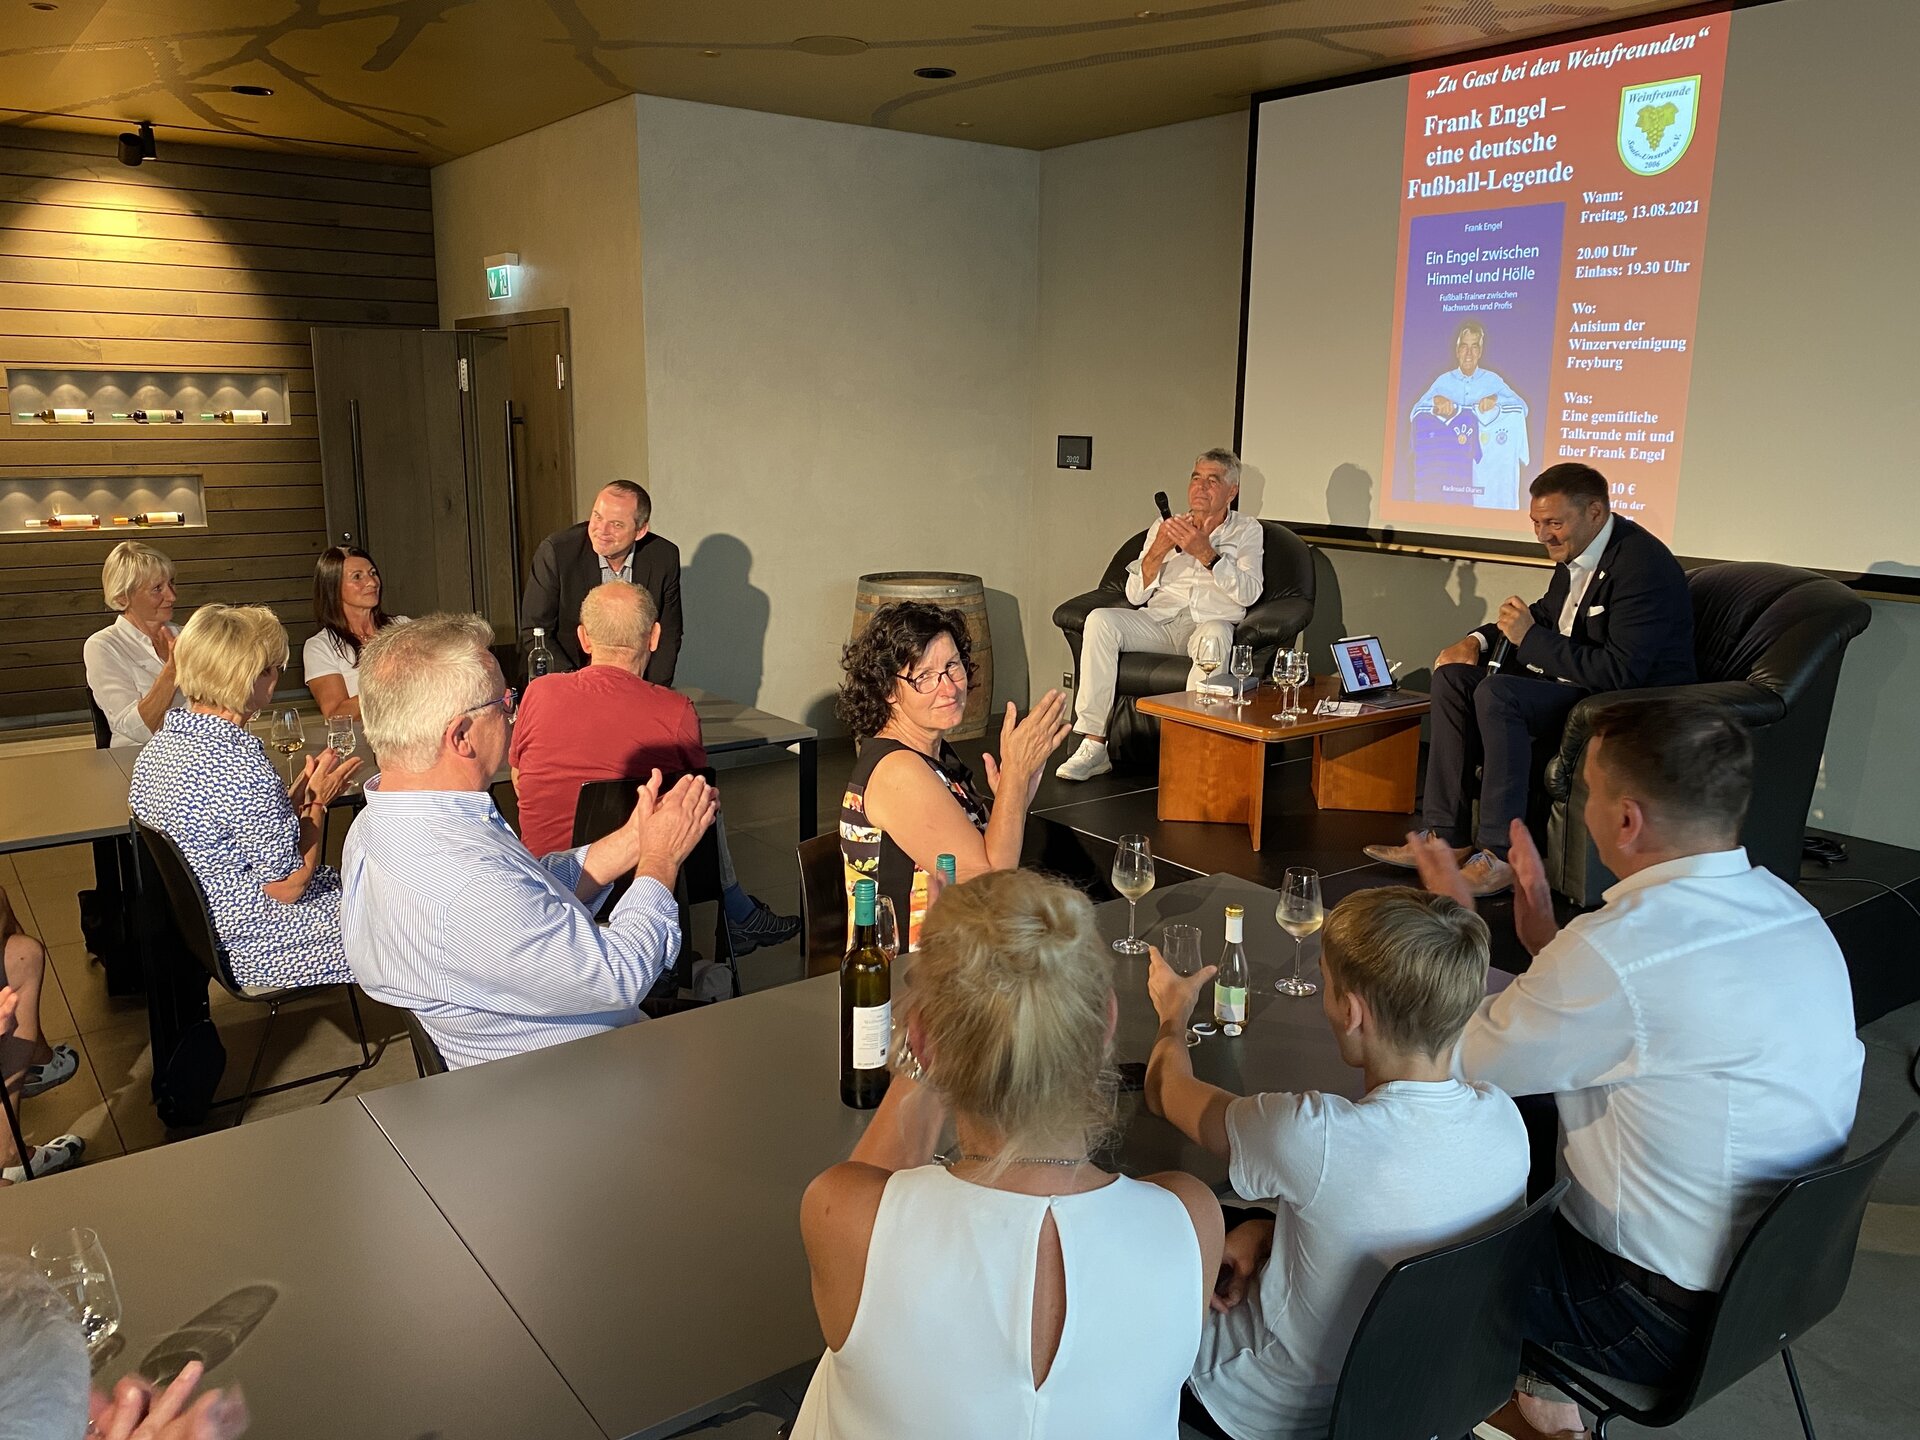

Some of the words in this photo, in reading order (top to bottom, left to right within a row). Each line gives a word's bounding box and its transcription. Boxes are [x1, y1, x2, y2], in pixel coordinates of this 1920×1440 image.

[1462, 70, 1499, 89] Gast
[1501, 61, 1528, 82] bei
[1530, 58, 1561, 77] den
[1628, 85, 1691, 104] Weinfreunde
[1424, 109, 1483, 136] Frank
[1488, 98, 1547, 128] Engel
[1426, 145, 1463, 166] eine
[1469, 131, 1557, 161] deutsche
[1644, 160, 1661, 169] 2006
[1407, 161, 1574, 199] Fußball-Legende
[1582, 191, 1623, 204] Wann:
[1580, 209, 1628, 223] Freitag,
[1632, 200, 1699, 219] 13.08.2021
[1464, 222, 1483, 232] Frank
[1484, 221, 1503, 232] Engel
[1426, 251, 1443, 265] Ein
[1446, 247, 1479, 266] Engel
[1481, 244, 1540, 261] zwischen
[1576, 246, 1609, 260] 20.00
[1612, 244, 1638, 258] Uhr
[1427, 269, 1473, 286] Himmel
[1475, 267, 1500, 283] und
[1502, 265, 1536, 282] Hölle
[1575, 265, 1623, 279] Einlass:
[1626, 261, 1660, 276] 19.30
[1663, 259, 1691, 273] Uhr
[1439, 291, 1486, 302] Fußball-Trainer
[1486, 290, 1518, 300] zwischen
[1442, 302, 1479, 312] Nachwuchs
[1479, 302, 1493, 310] und
[1494, 301, 1513, 310] Profis
[1572, 302, 1597, 315] Wo:
[1569, 320, 1620, 333] Anisium
[1623, 319, 1646, 332] der
[1568, 337, 1687, 353] Winzervereinigung
[1566, 356, 1624, 371] Freyburg
[1563, 392, 1593, 405] Was:
[1561, 409, 1589, 422] Eine
[1591, 410, 1659, 425] gemütliche
[1453, 423, 1473, 437] DDR
[1560, 427, 1622, 440] Talkrunde
[1625, 429, 1646, 442] mit
[1649, 430, 1675, 443] und
[1066, 455, 1080, 464] 20:02
[1558, 445, 1586, 457] über
[1588, 446, 1626, 459] Frank
[1629, 447, 1666, 464] Engel
[1611, 482, 1625, 495] 10
[1628, 483, 1637, 495] €
[1619, 500, 1628, 509] in
[1629, 500, 1646, 510] der
